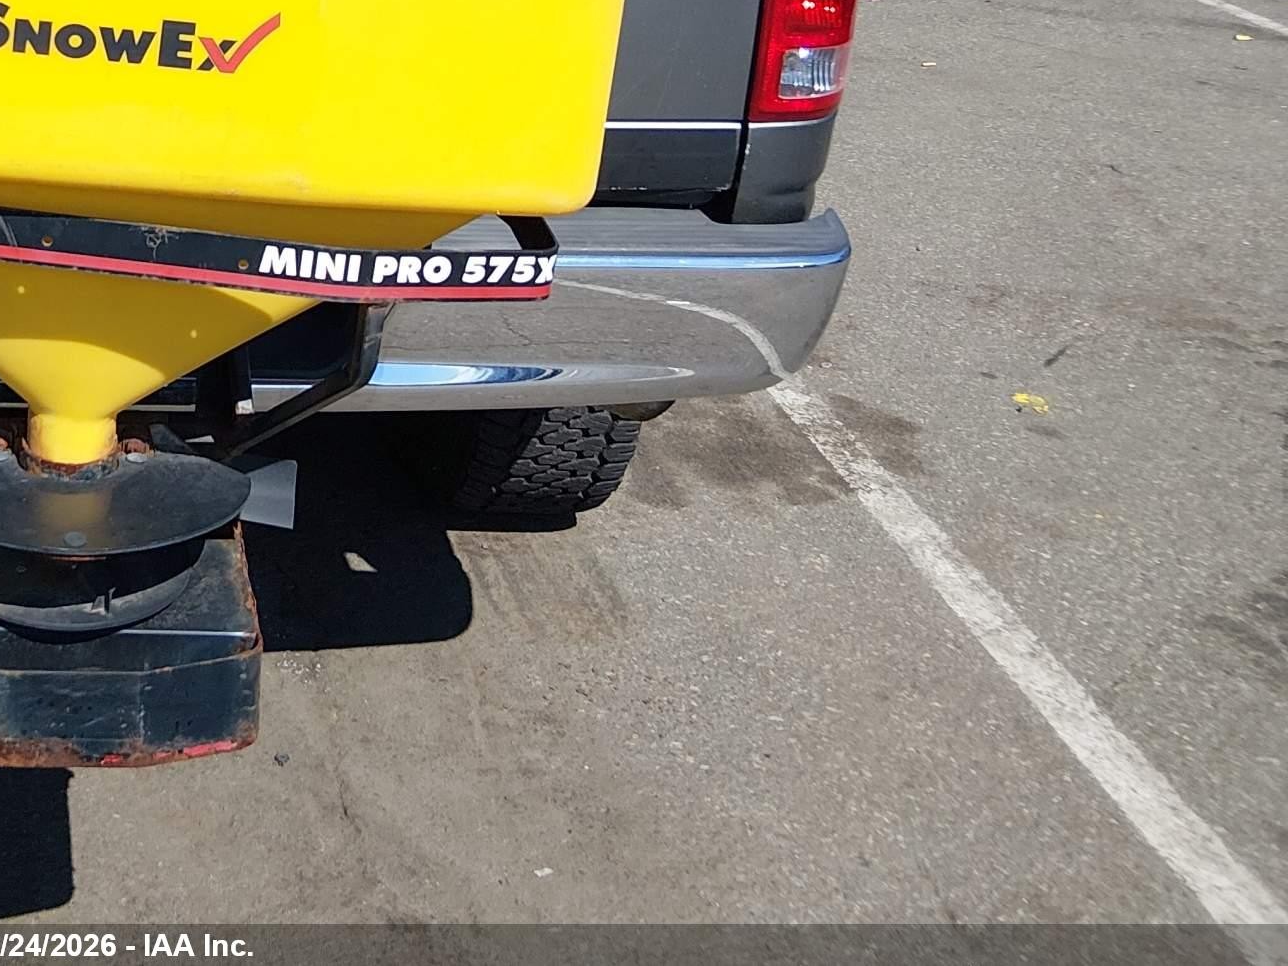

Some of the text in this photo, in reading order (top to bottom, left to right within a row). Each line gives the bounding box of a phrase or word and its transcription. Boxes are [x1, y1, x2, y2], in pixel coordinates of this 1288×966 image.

[258, 244, 558, 284] MINI PRO 575X
